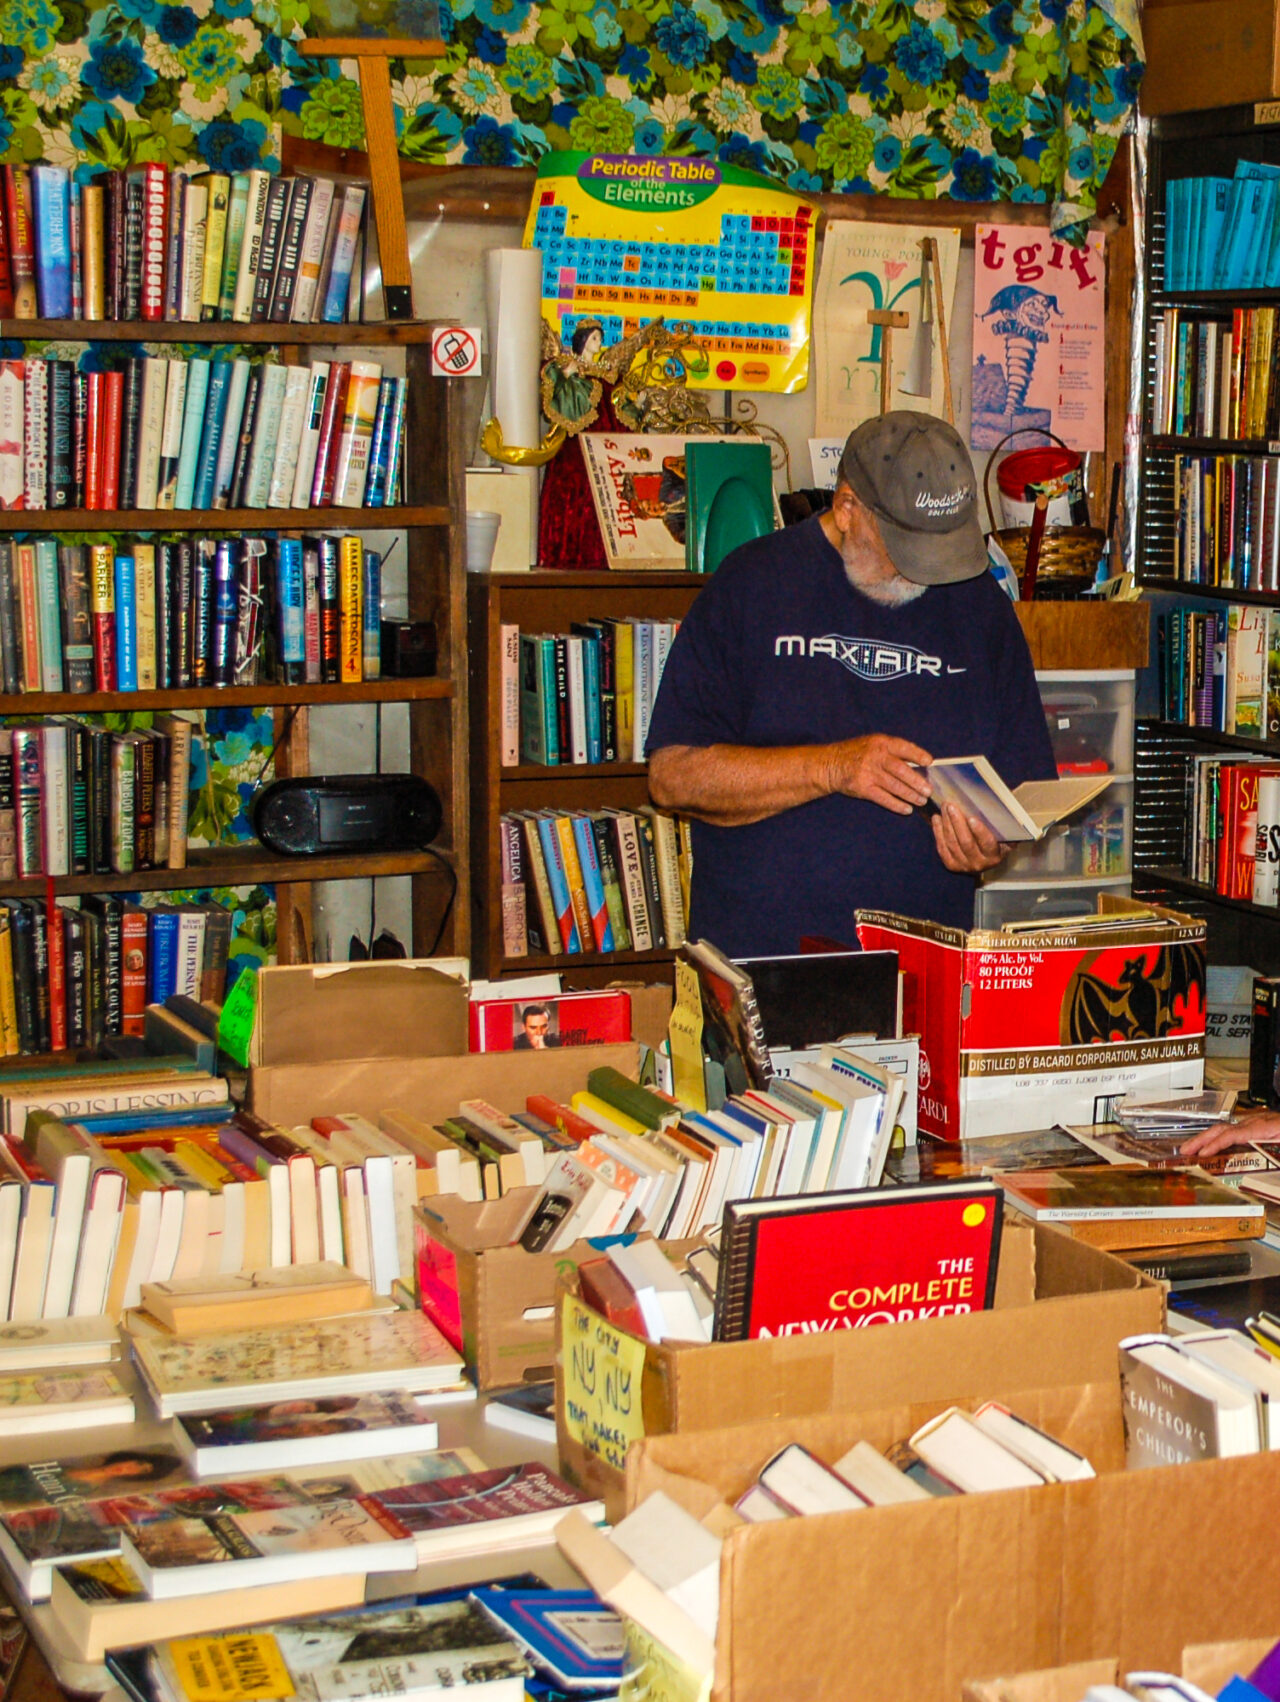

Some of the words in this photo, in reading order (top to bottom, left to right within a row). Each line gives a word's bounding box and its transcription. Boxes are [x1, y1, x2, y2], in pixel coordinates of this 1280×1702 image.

[591, 159, 665, 178] Periodic
[669, 162, 716, 181] Table
[631, 178, 644, 189] of
[646, 178, 666, 190] the
[14, 170, 25, 207] HILARY
[253, 177, 268, 226] DOWNTOWN
[604, 184, 695, 207] Elements
[16, 208, 28, 249] MANTEL
[252, 235, 261, 246] ED
[980, 228, 1098, 291] tgif
[54, 415, 71, 455] COUNSEL
[607, 455, 638, 539] Liberty
[96, 553, 107, 599] PARKER
[347, 582, 359, 658] PATTERSON
[557, 644, 565, 666] THE
[558, 667, 567, 699] CHILD
[173, 730, 185, 757] LARK
[121, 770, 134, 812] BAMBOO
[121, 815, 134, 851] PEOPLE
[508, 825, 521, 882] ANGELICA
[623, 831, 639, 873] LOVE
[512, 885, 525, 941] SHARON
[632, 902, 649, 938] CHANCE
[108, 926, 120, 949] THE
[980, 936, 1020, 948] PUERTO
[1022, 936, 1053, 947] RICAN
[1055, 935, 1077, 946] RUM
[108, 951, 120, 985] BLACK
[979, 953, 997, 964] 40%
[999, 953, 1016, 964] Alc.
[1017, 952, 1027, 966] by
[1029, 952, 1044, 964] Vol.
[979, 966, 993, 977] 80
[994, 965, 1035, 977] PROOF
[979, 979, 992, 990] 12
[994, 978, 1033, 990] LITERS
[108, 988, 120, 1024] COUNT
[743, 984, 776, 1081] FREDERI
[969, 1055, 1017, 1072] DISTILLED
[1019, 1056, 1031, 1070] BY
[1032, 1053, 1074, 1069] BACARDI
[1075, 1048, 1140, 1066] CORPORATION,
[1141, 1047, 1159, 1061] SAN
[1161, 1045, 1186, 1060] JUAN,
[24, 1101, 106, 1117] DORIS
[112, 1090, 217, 1113] LESSING
[919, 1095, 950, 1124] ARDI
[1223, 1156, 1261, 1171] Painting
[938, 1257, 975, 1275] THE
[829, 1277, 974, 1311] COMPLETE
[572, 1340, 596, 1397] NY
[606, 1366, 632, 1416] NY
[1155, 1376, 1175, 1399] THE
[1129, 1390, 1207, 1451] EMPEROR'S
[1135, 1427, 1192, 1465] CHILDR
